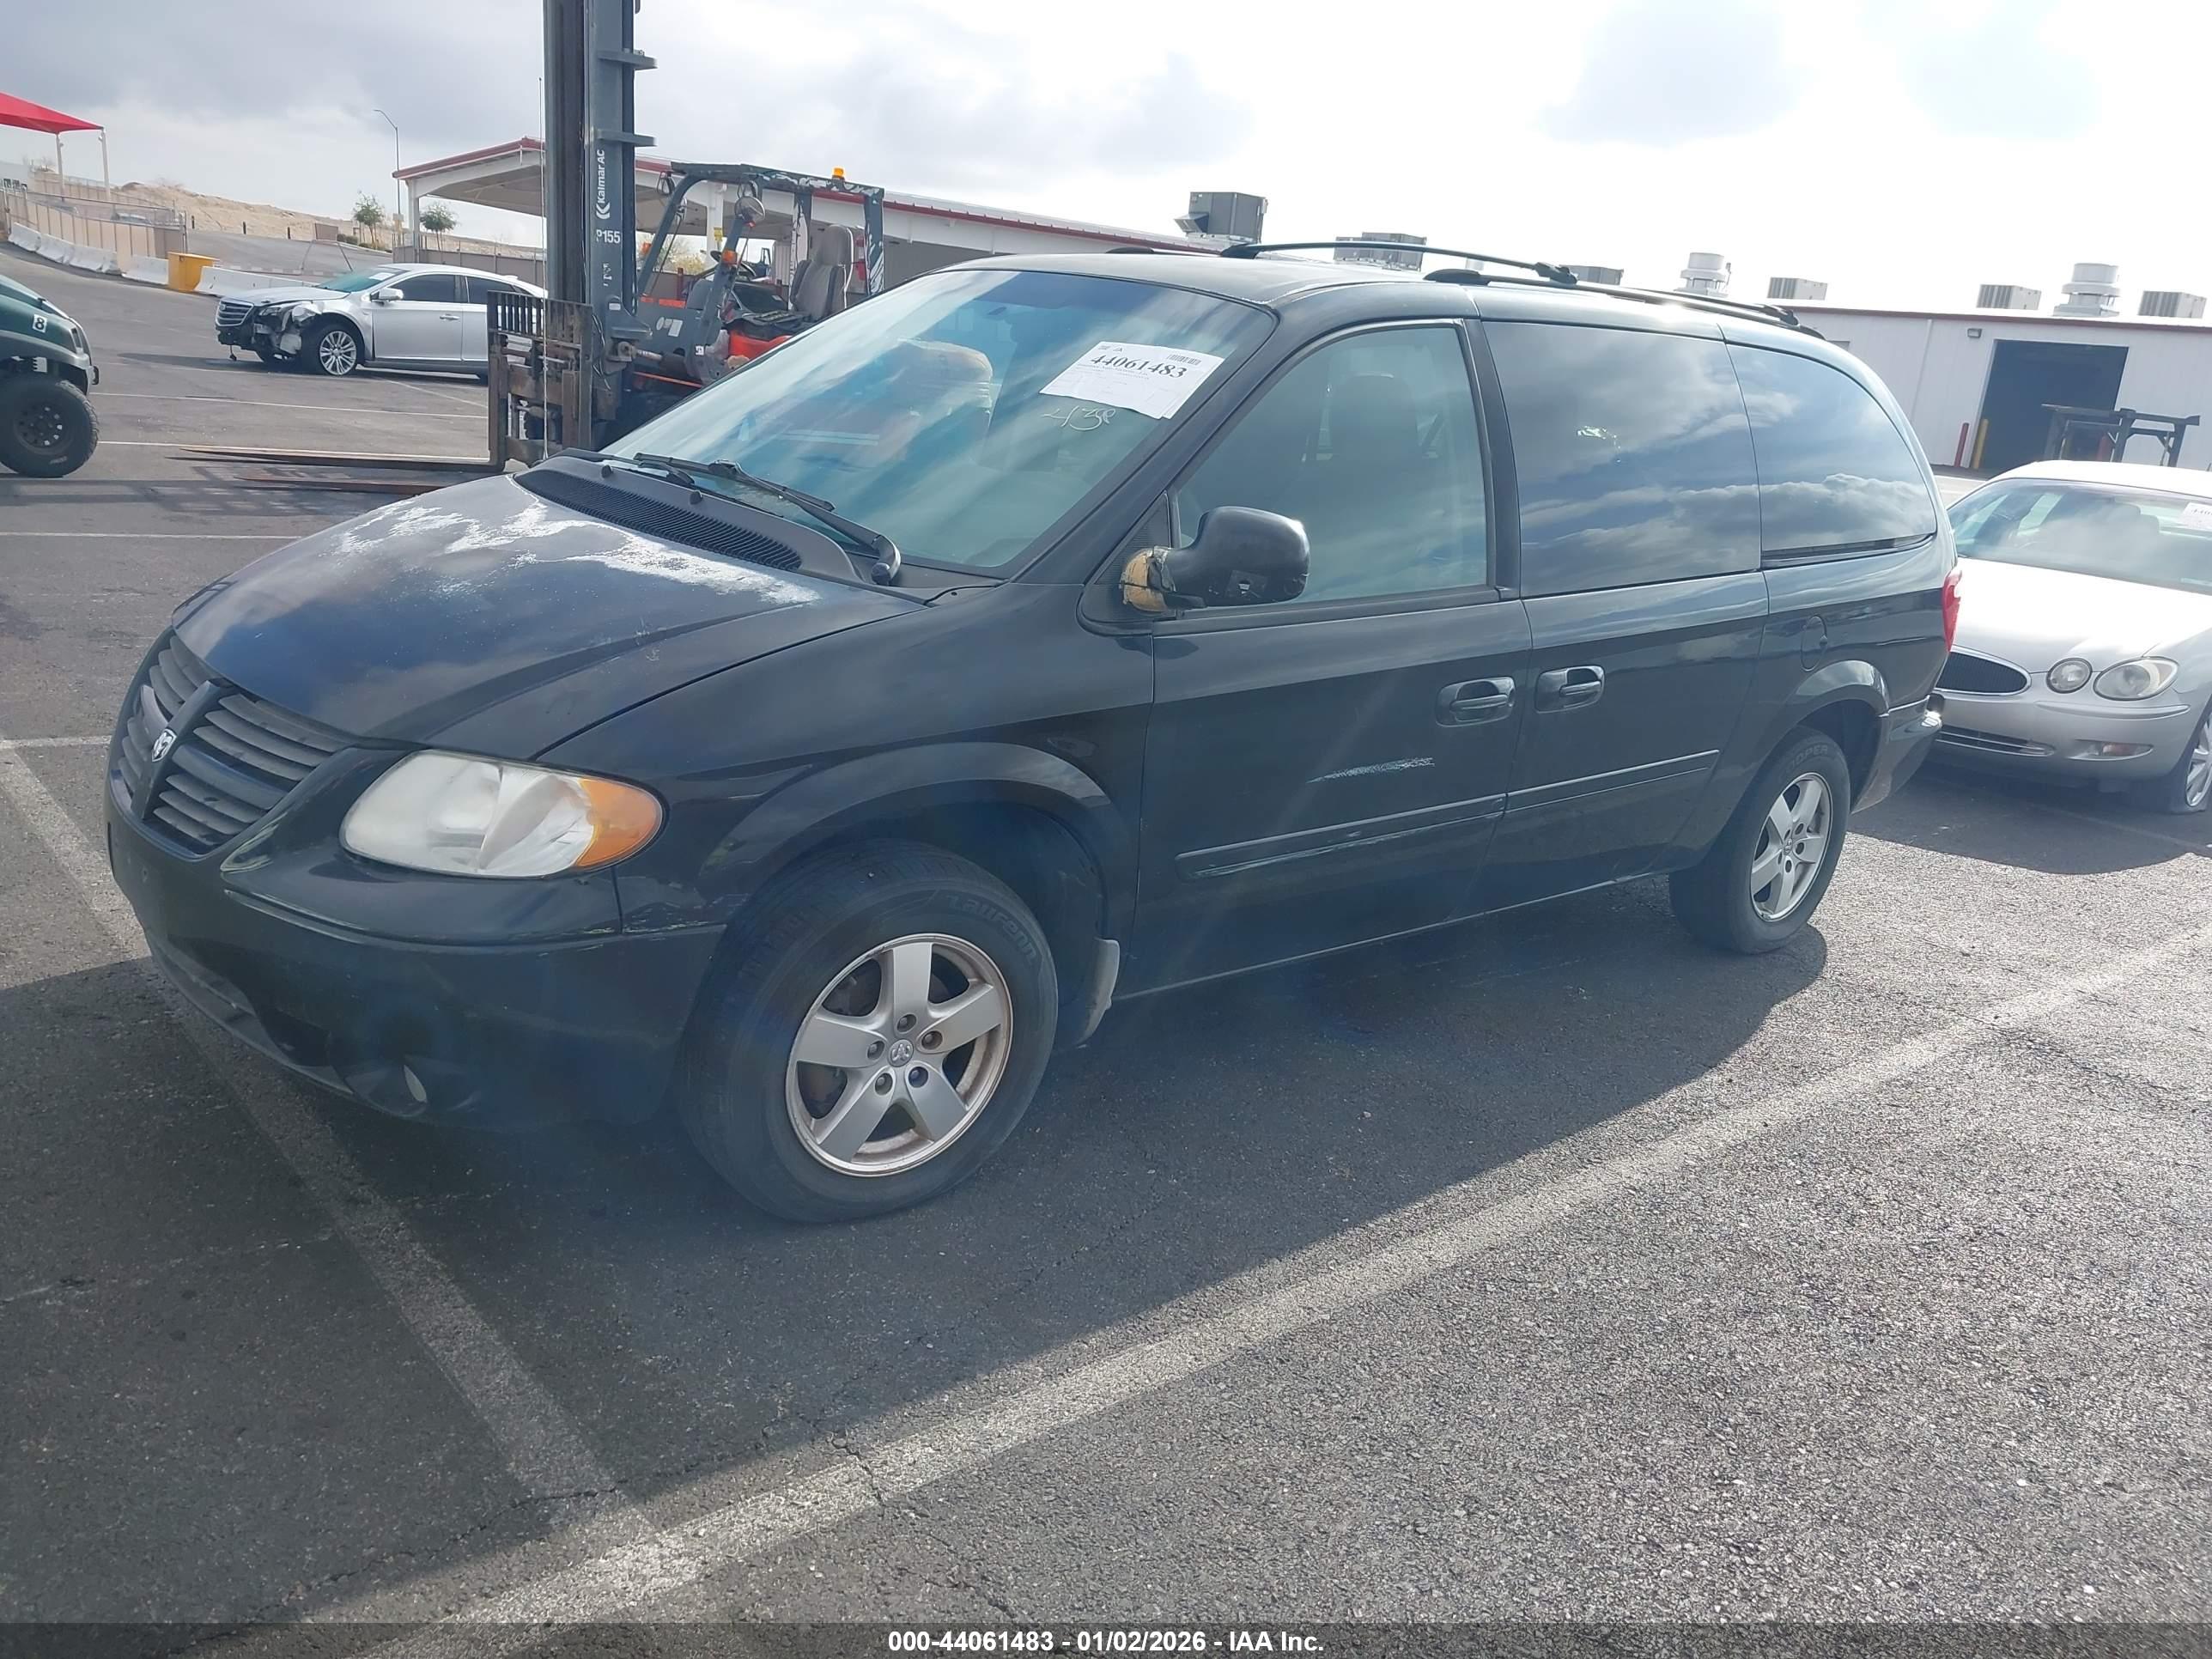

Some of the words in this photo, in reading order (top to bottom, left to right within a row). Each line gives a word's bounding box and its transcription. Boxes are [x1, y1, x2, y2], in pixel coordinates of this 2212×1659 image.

[597, 165, 605, 204] Kalmar
[35, 317, 45, 331] 8
[1091, 355, 1188, 379] 44061483
